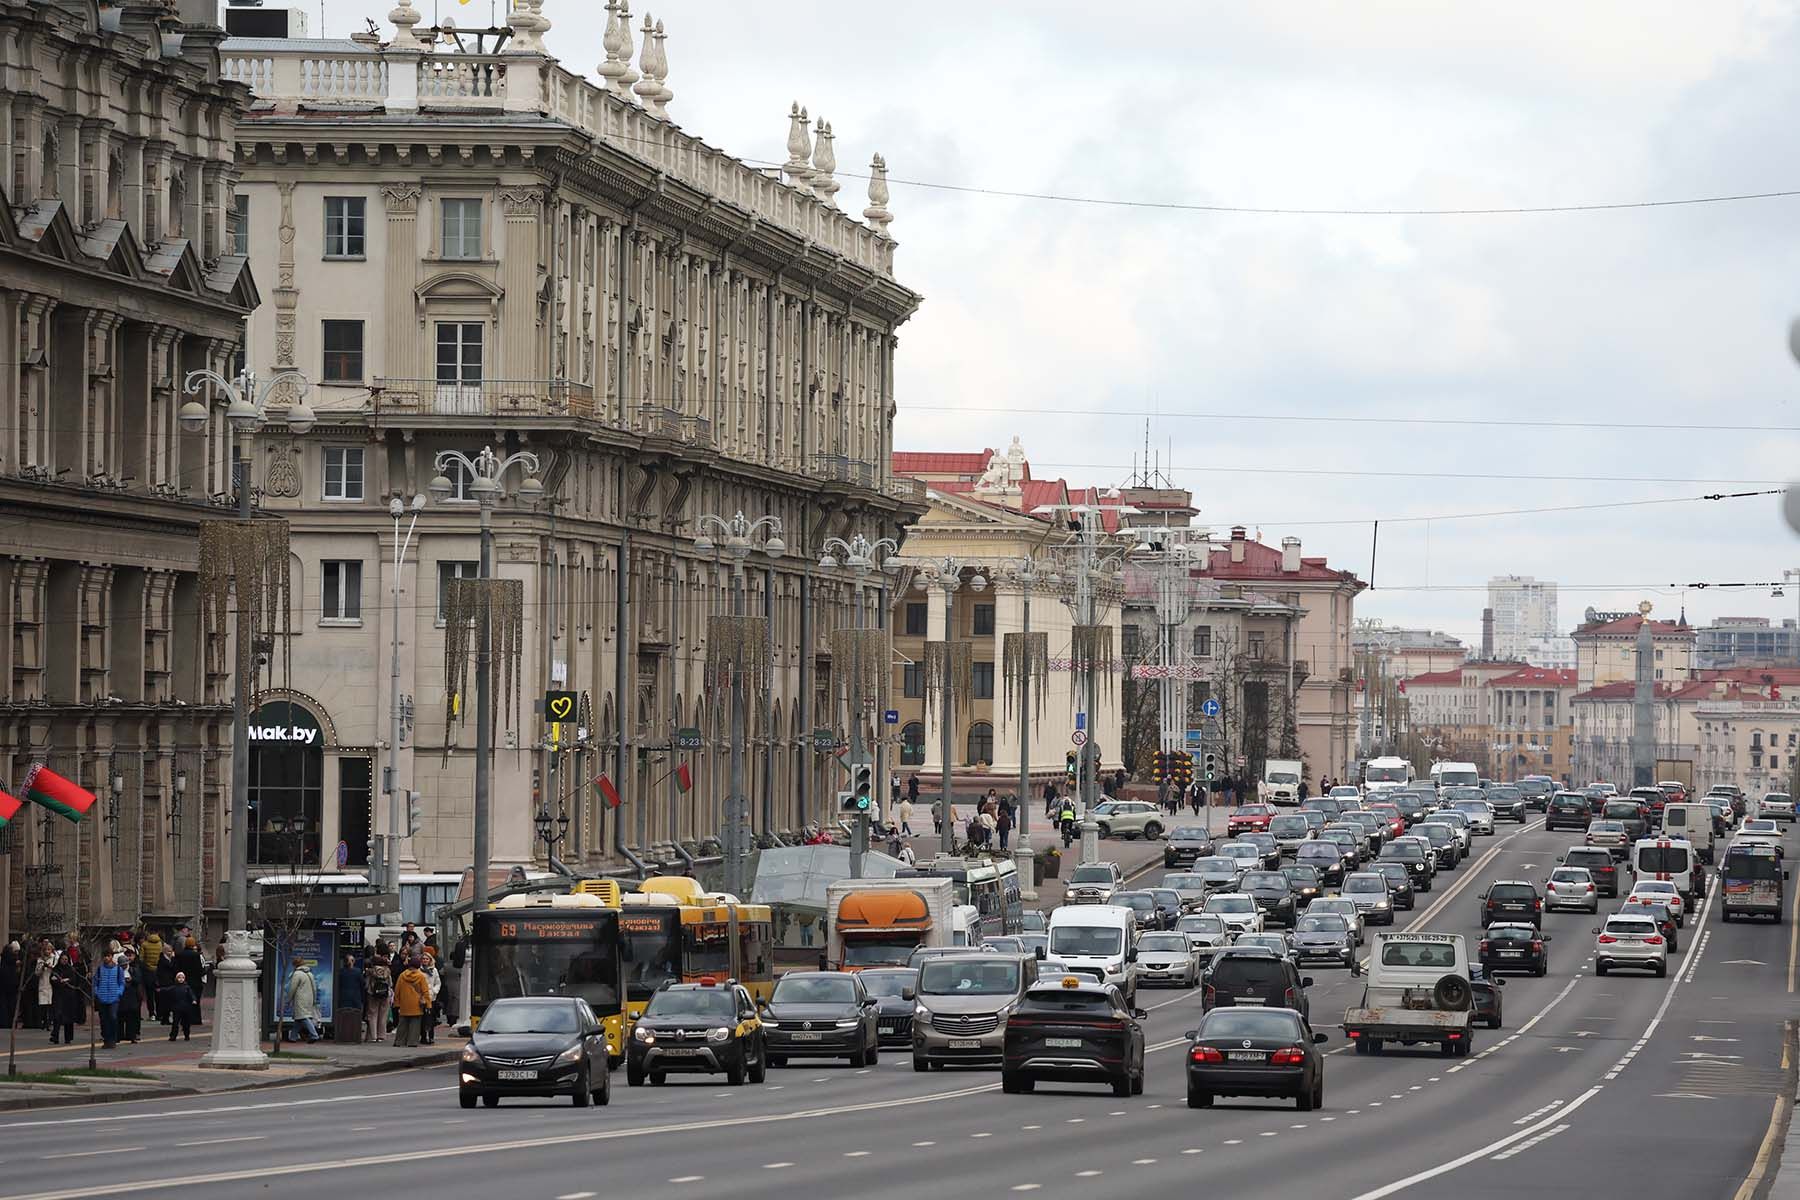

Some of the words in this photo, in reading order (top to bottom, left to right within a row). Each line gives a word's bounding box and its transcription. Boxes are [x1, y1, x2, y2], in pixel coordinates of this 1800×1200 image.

[248, 725, 317, 744] Mak.by
[680, 738, 700, 746] 8-23
[814, 738, 832, 746] 8-23
[501, 924, 517, 936] 69
